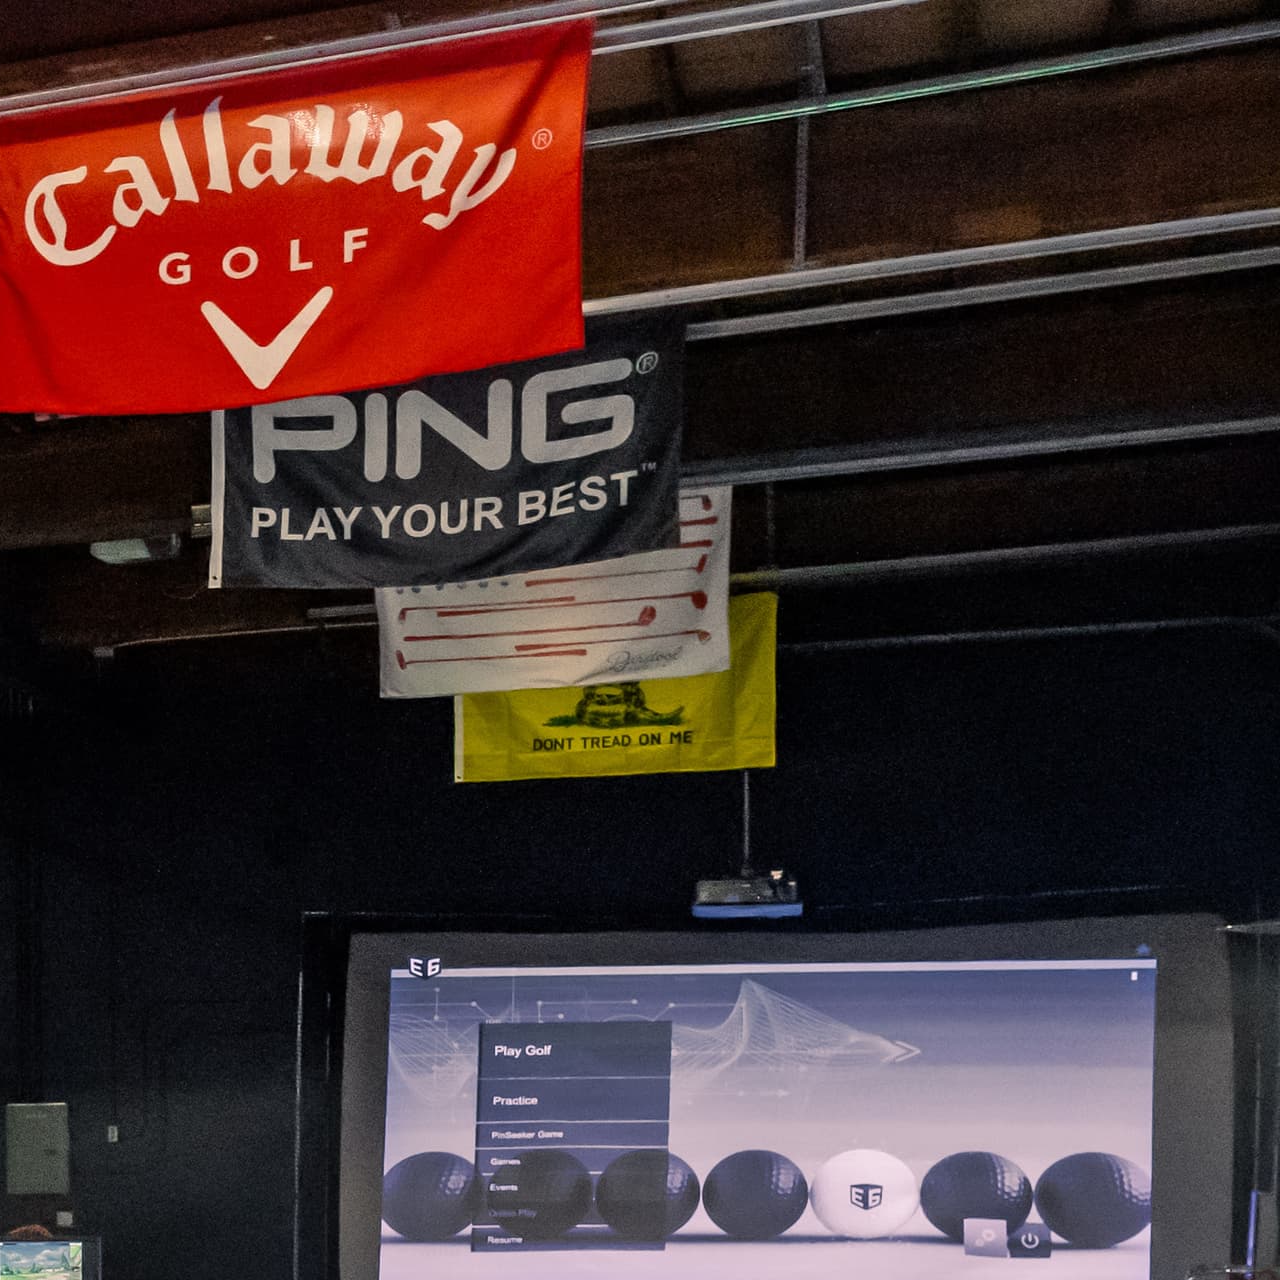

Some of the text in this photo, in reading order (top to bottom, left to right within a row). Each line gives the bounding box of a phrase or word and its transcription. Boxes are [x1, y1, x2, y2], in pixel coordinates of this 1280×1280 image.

[25, 96, 517, 266] Callaway
[158, 227, 369, 285] GOLF
[251, 357, 636, 484] PING
[251, 470, 639, 541] PLAY YOUR BEST
[532, 730, 695, 751] DONT TREAD ON ME
[409, 957, 441, 978] E6
[494, 1044, 552, 1059] Play Golf
[492, 1095, 539, 1106] Practice
[537, 1130, 564, 1139] Game
[489, 1183, 518, 1192] Events
[849, 1185, 882, 1210] E6
[487, 1235, 523, 1245] Resume
